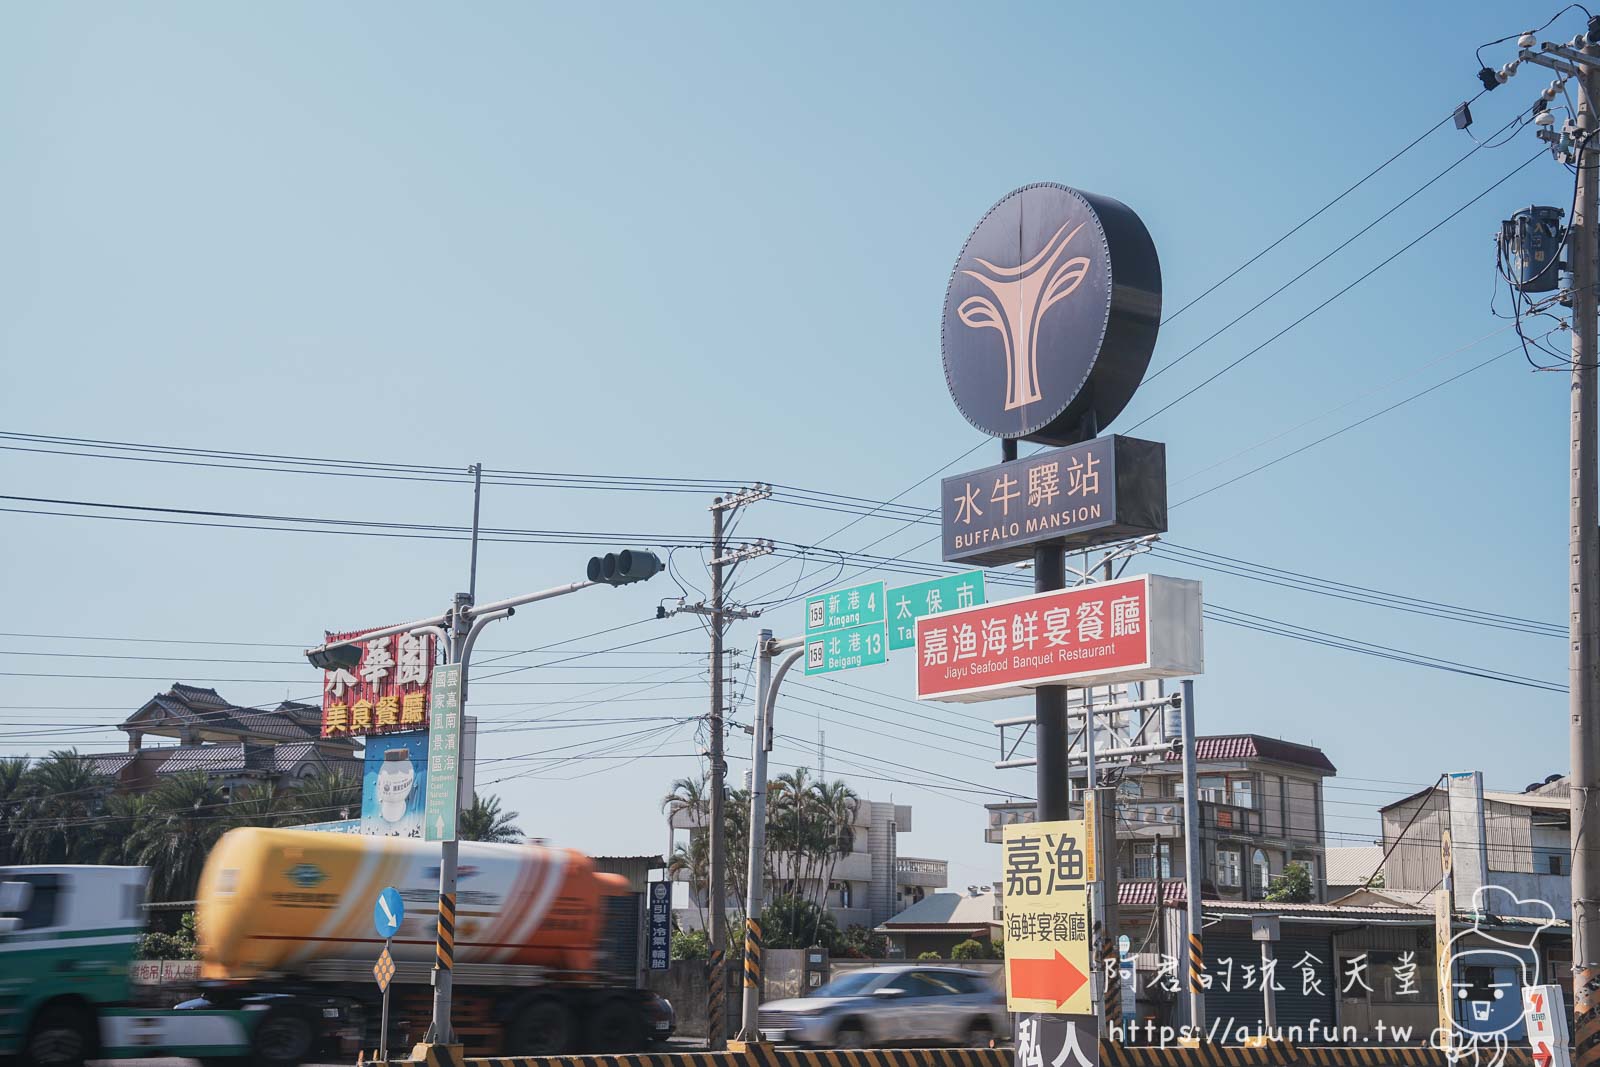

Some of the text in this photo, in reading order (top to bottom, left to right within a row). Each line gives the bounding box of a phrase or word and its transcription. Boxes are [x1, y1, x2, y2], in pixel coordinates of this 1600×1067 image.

[954, 451, 1100, 525] 水牛驛站
[955, 503, 1101, 549] BUFFALO MANSION
[810, 607, 824, 621] 159
[828, 591, 876, 614] 新港 4
[828, 612, 861, 627] Xingang
[895, 581, 974, 620] 太保市
[809, 647, 823, 661] 159
[828, 632, 881, 656] 北港 13
[828, 654, 862, 669] Beigang
[944, 643, 1116, 680] Jiayu Seafood Banquet Restaurant
[325, 692, 426, 734] 美食餐廳
[431, 671, 447, 772] 國家風景區
[445, 670, 458, 771] 雲嘉南濱海
[1018, 1018, 1094, 1067] 私人
